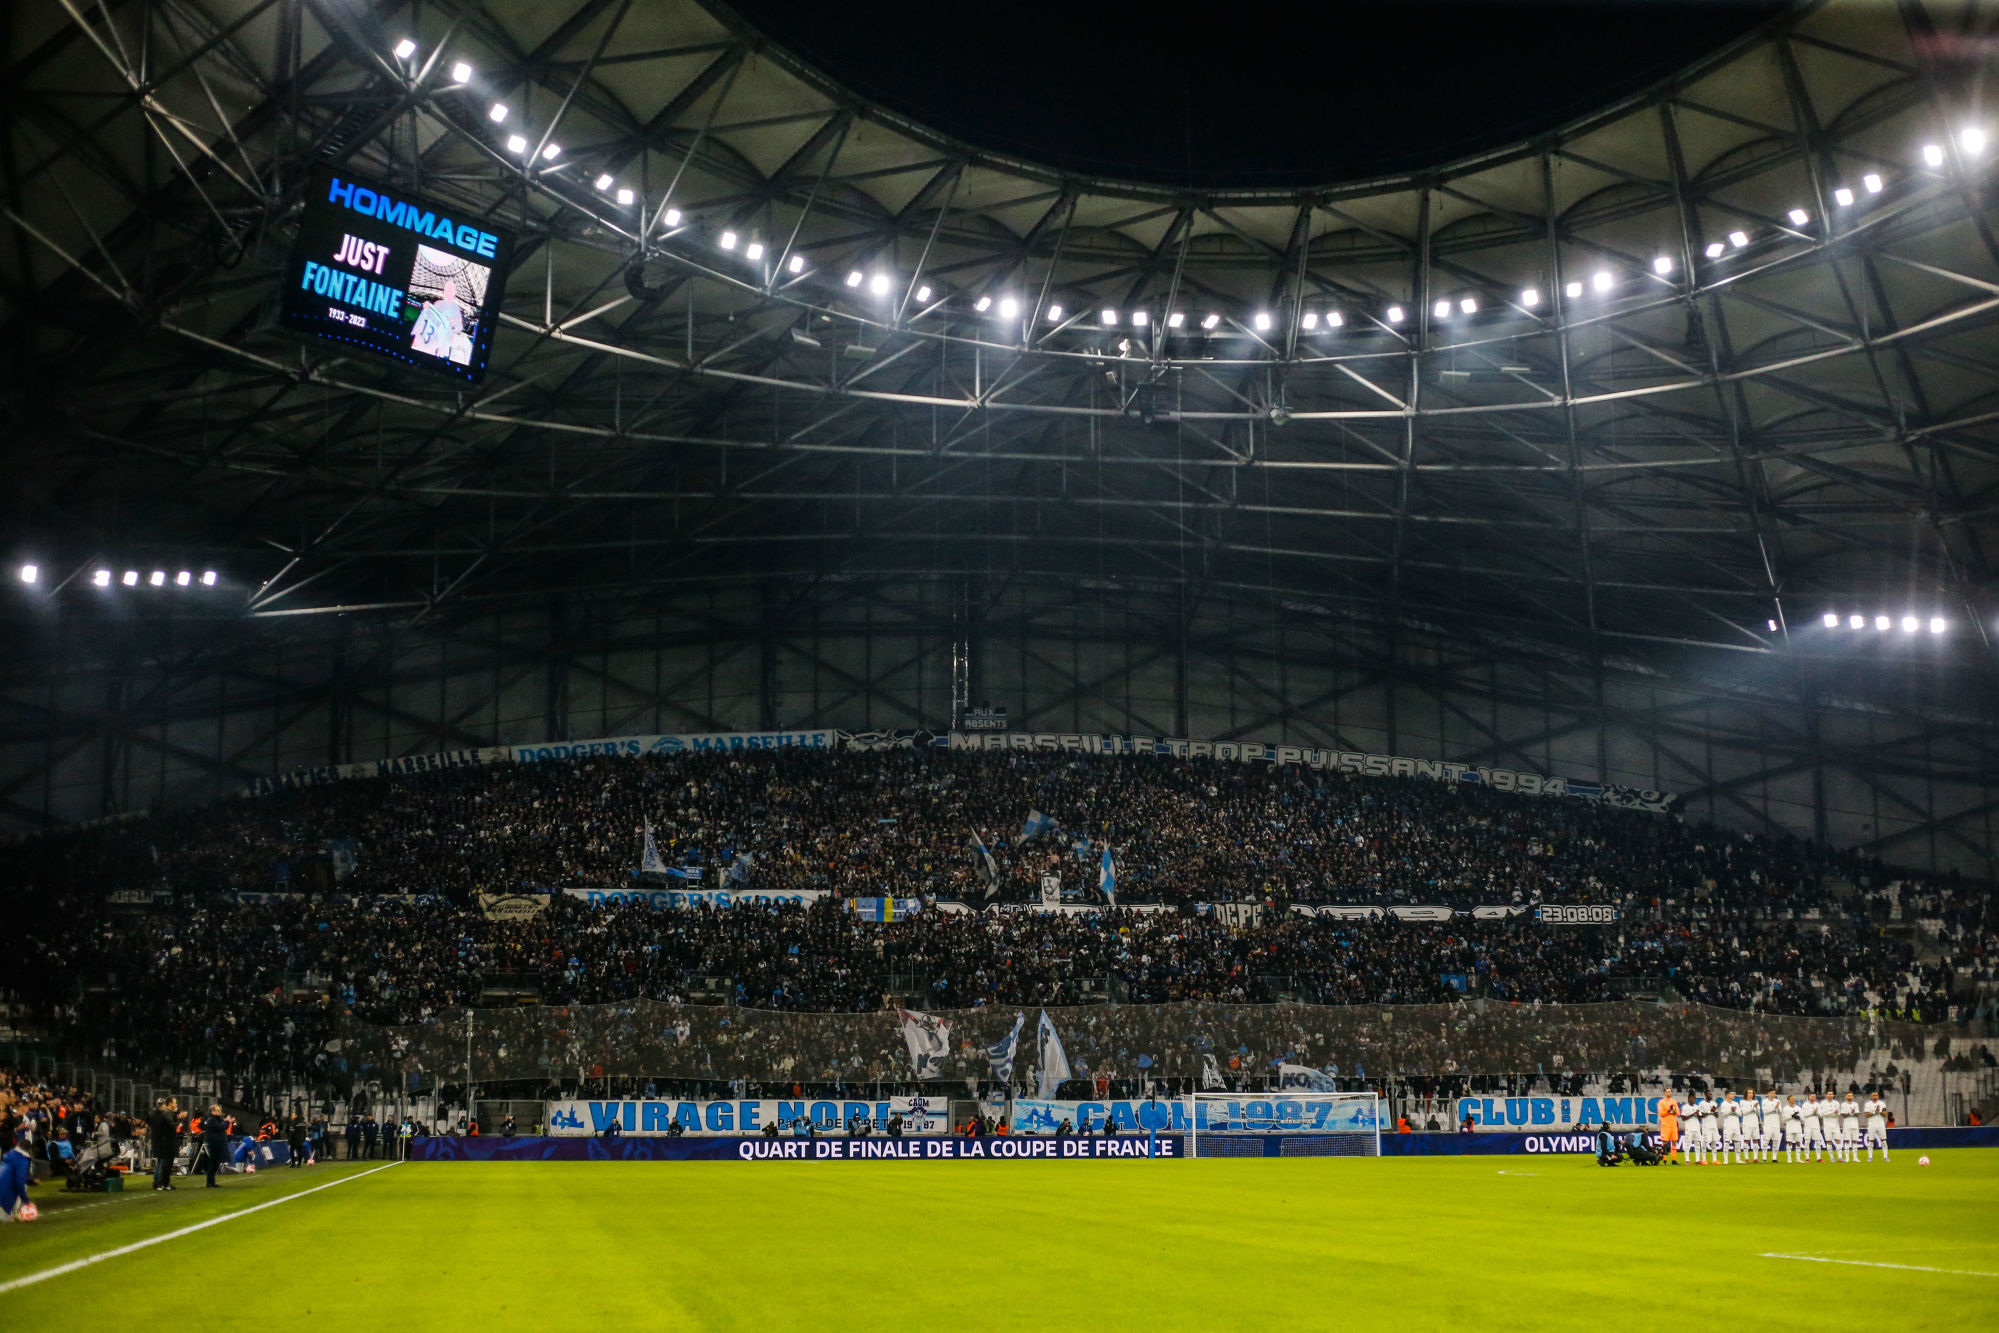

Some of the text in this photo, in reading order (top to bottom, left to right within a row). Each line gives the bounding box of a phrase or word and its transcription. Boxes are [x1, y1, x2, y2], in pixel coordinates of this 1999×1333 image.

[328, 177, 499, 260] HOMMAGE
[333, 233, 391, 275] JUST
[301, 260, 405, 319] FONTAINE
[965, 719, 1008, 729] ABSENTS
[1165, 738, 1267, 764] TROP
[1276, 745, 1468, 784] PUISSANT
[1478, 766, 1568, 798] 1994
[588, 1101, 761, 1132] VIRAGE
[908, 1097, 930, 1108] CAOM
[1076, 1100, 1334, 1132] CAOM 1987
[1459, 1098, 1556, 1126] CLUB
[1561, 1099, 1571, 1124] DES
[738, 1141, 810, 1161] QUART
[815, 1141, 843, 1159] DE
[848, 1141, 921, 1159] FINALE
[926, 1140, 954, 1158] DE
[959, 1140, 987, 1158] LA
[989, 1140, 1057, 1158] COUPE
[1062, 1140, 1090, 1158] DE
